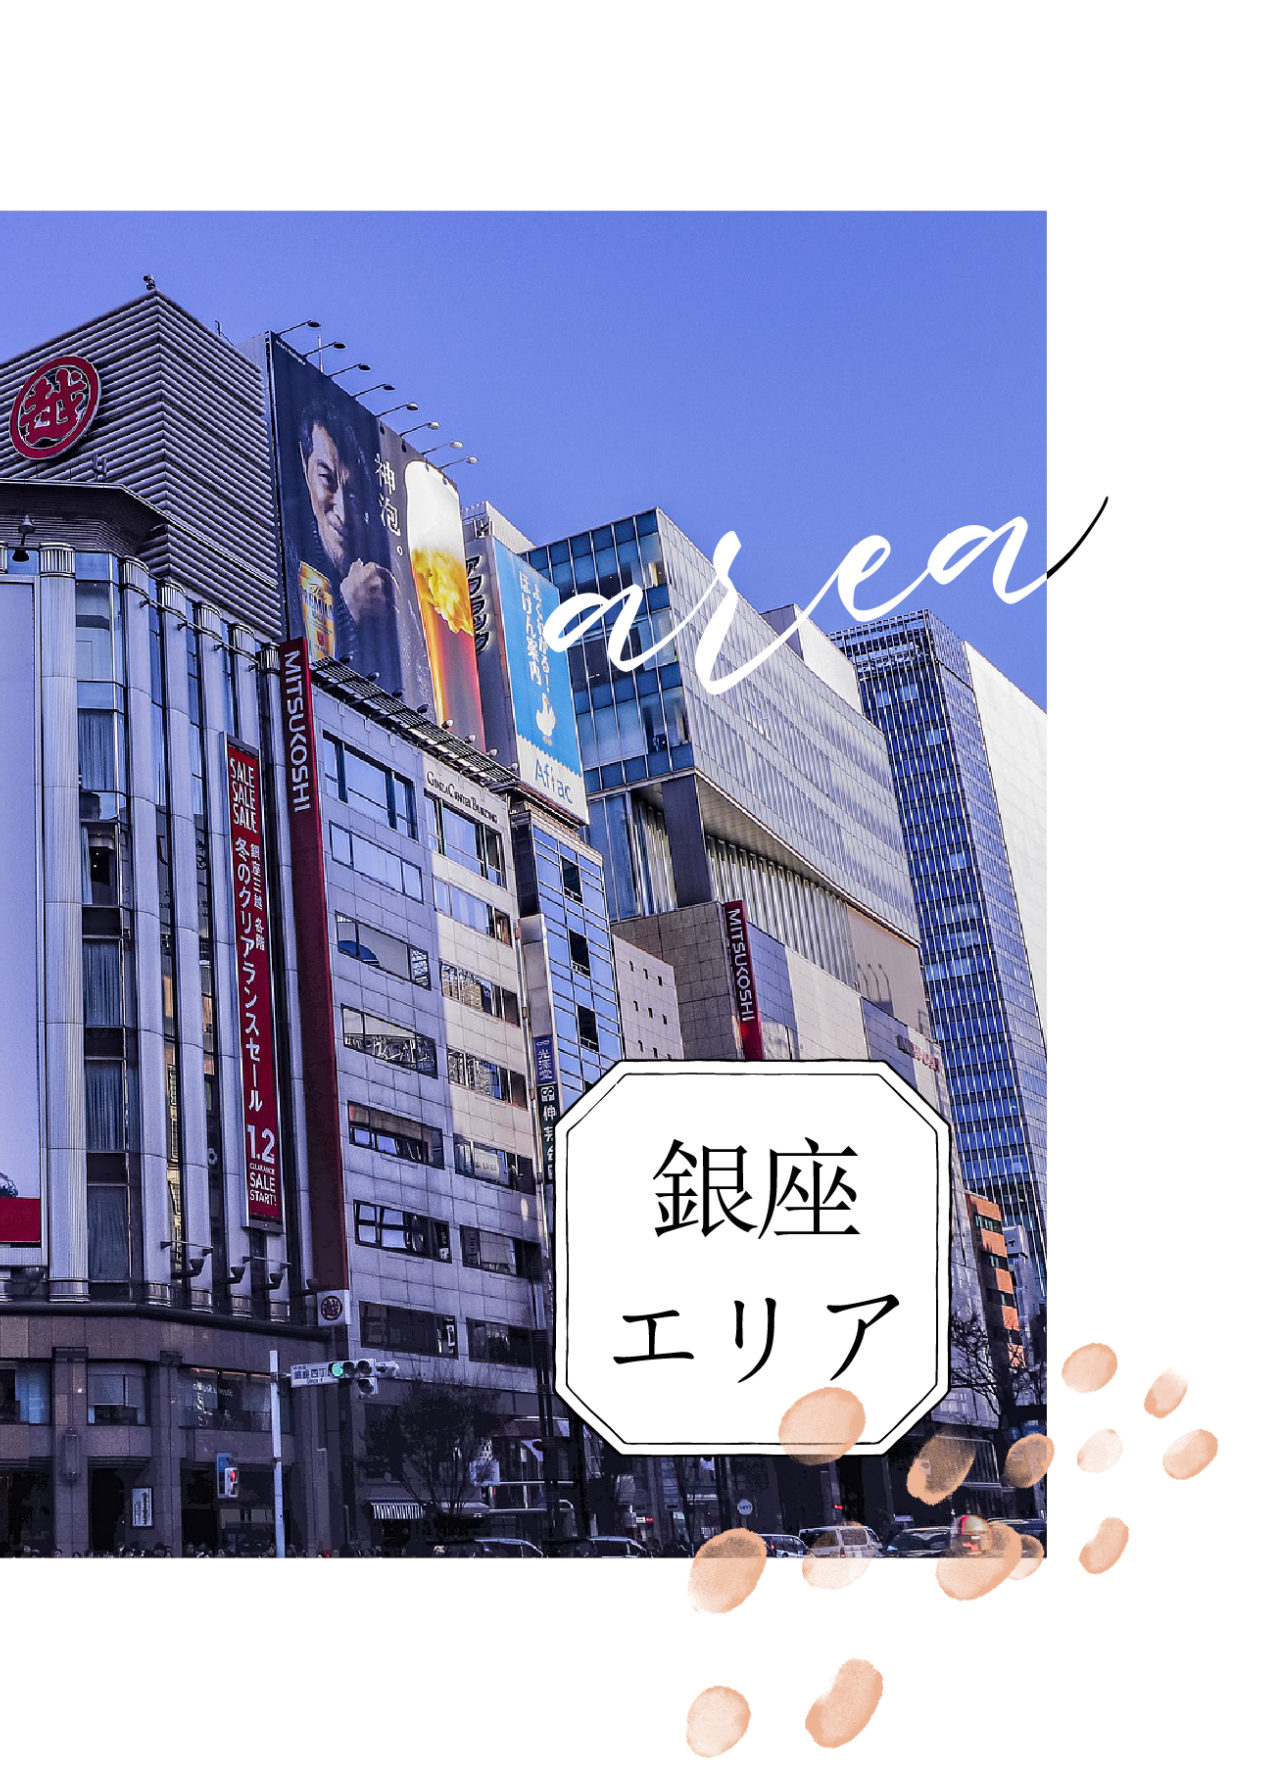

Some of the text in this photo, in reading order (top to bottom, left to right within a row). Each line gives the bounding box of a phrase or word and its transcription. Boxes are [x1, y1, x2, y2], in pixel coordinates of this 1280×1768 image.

[284, 650, 311, 812] MITSUKOSHI
[230, 757, 255, 788] SALE
[535, 758, 573, 804] Aflac
[231, 780, 256, 811] SALE
[233, 803, 258, 834] SALE
[235, 836, 263, 1112] 冬のクリアランスセール
[727, 908, 756, 1022] MITSUKOSHI
[247, 1124, 275, 1164] 1.2
[250, 1172, 276, 1193] SALE
